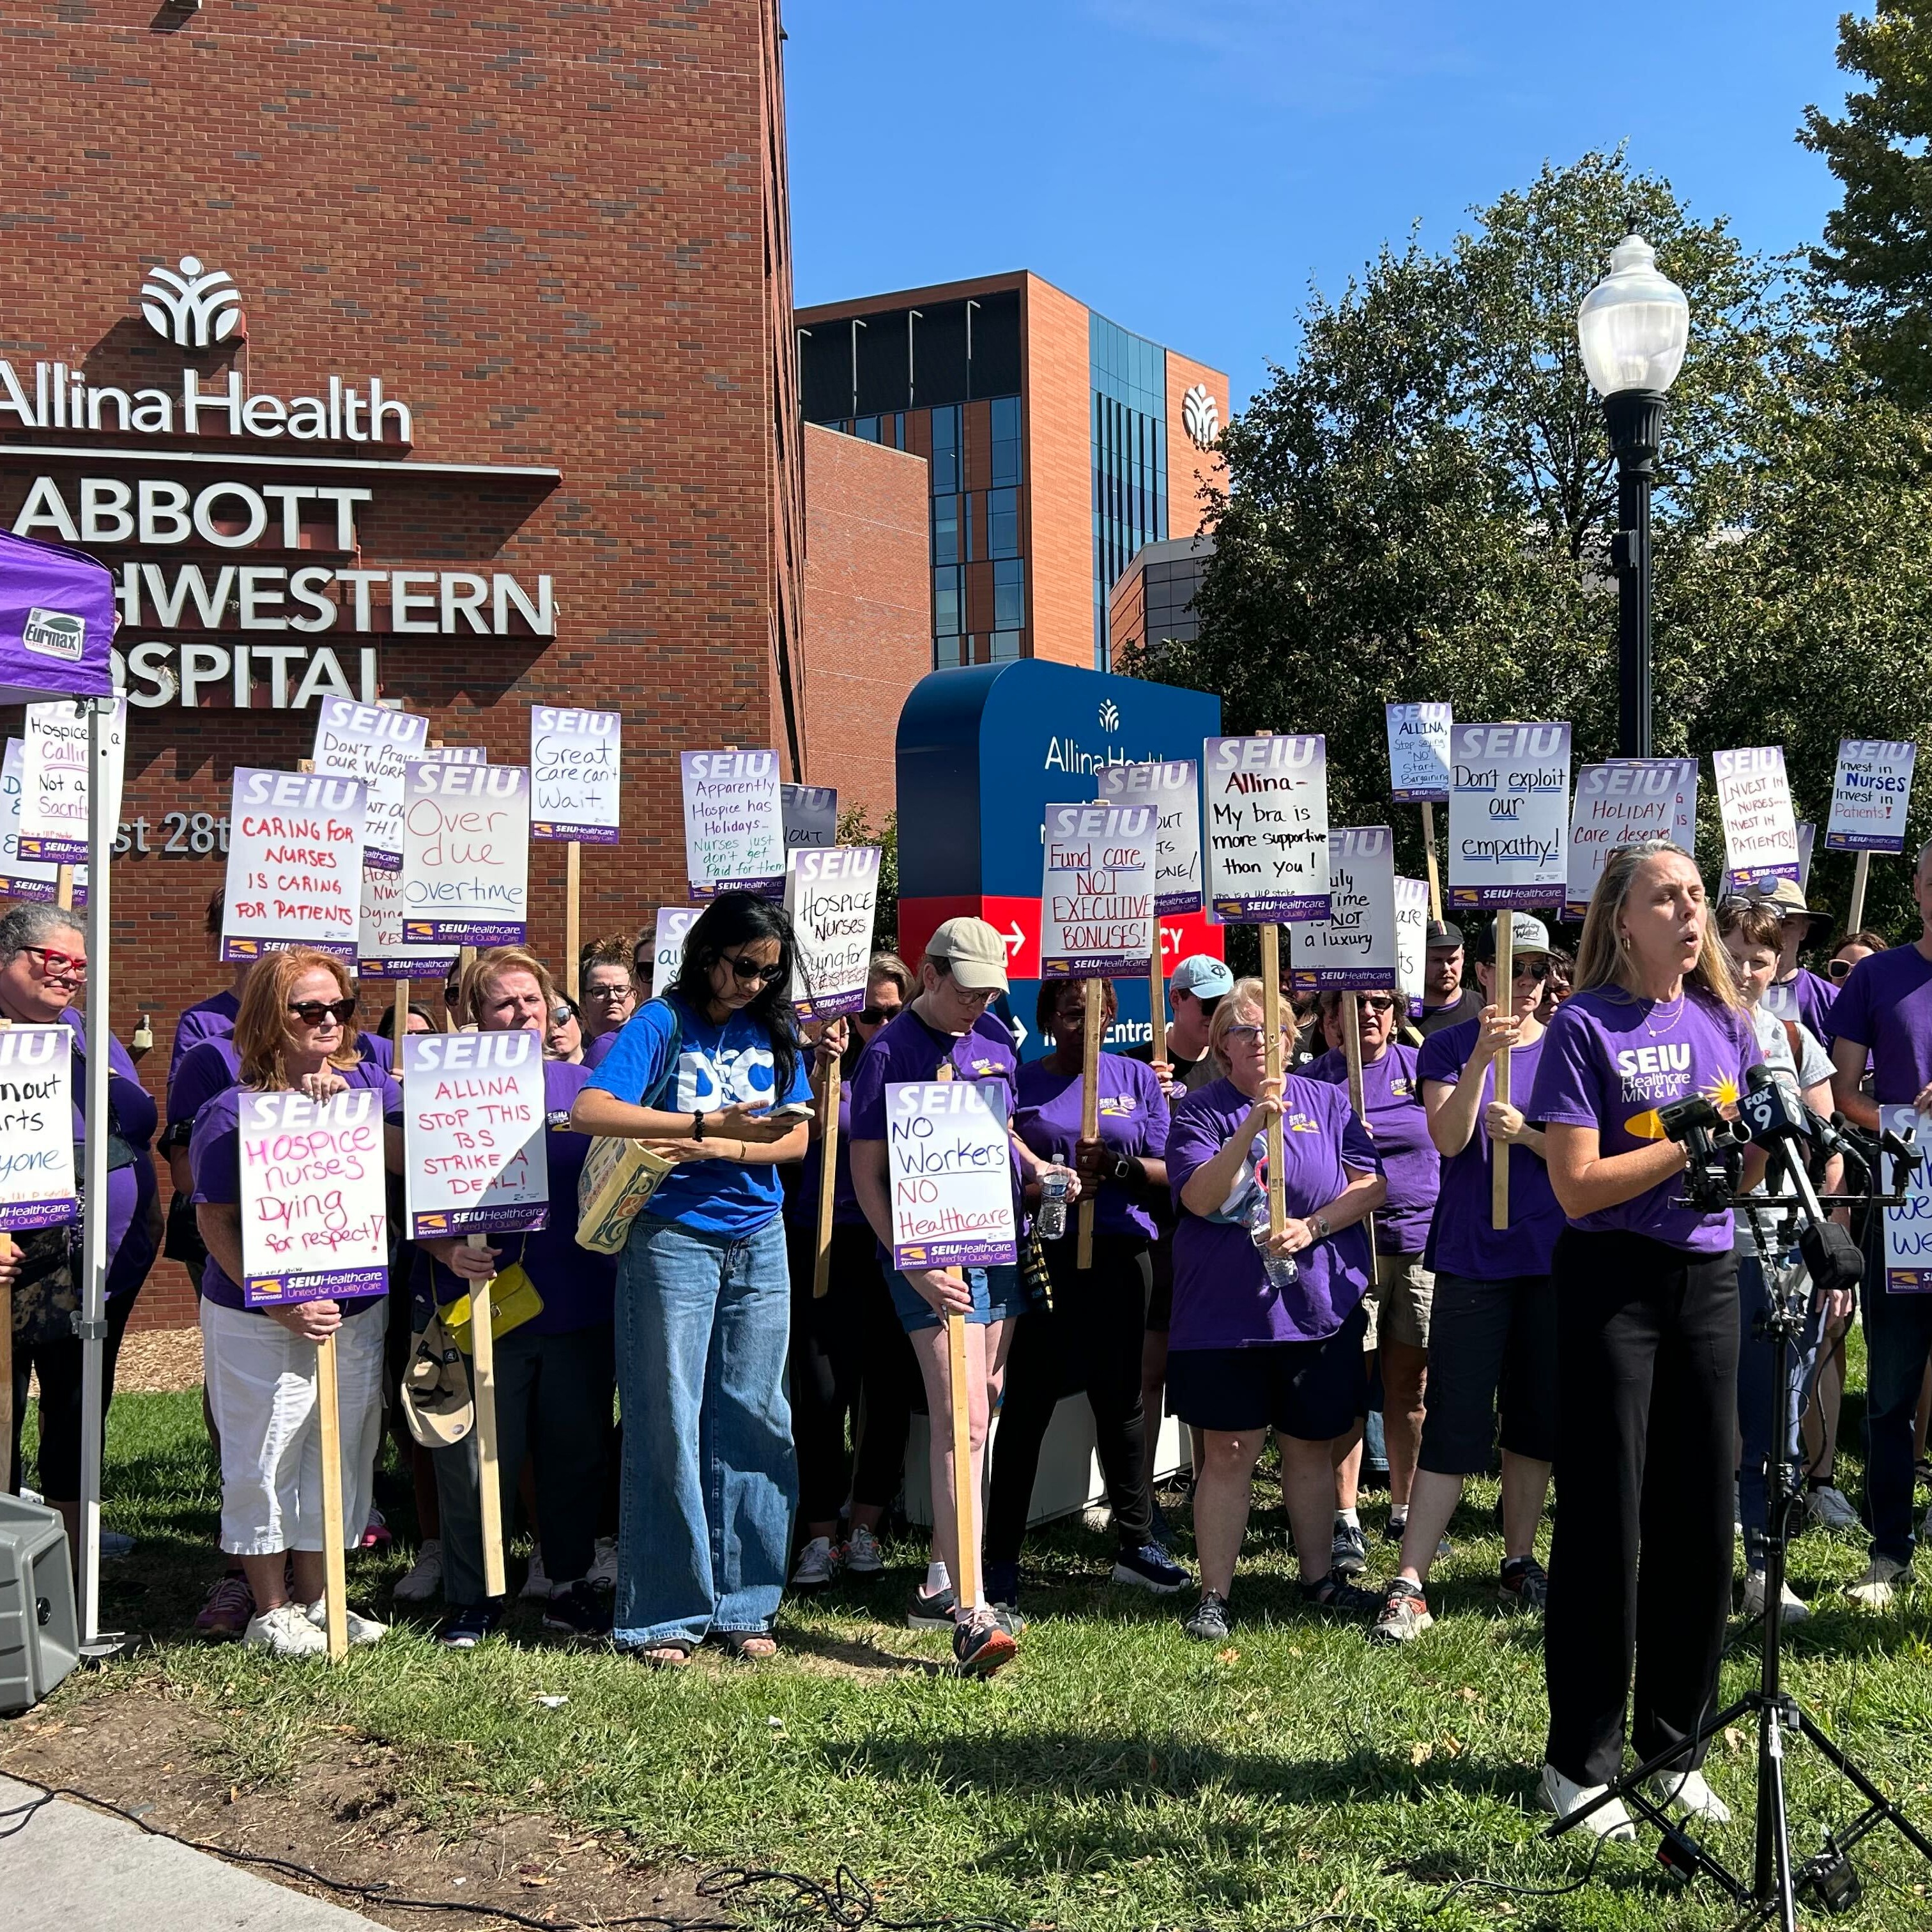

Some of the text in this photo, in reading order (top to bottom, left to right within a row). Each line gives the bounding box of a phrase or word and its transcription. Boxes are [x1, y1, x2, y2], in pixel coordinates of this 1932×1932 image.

[0, 360, 411, 443] Allina Health
[13, 476, 373, 551] ABBOTT
[26, 624, 77, 650] Eurmax
[326, 702, 419, 742] SEIU
[538, 709, 613, 736] SEIU
[1391, 705, 1446, 722] SEIU
[1399, 721, 1447, 735] ALLINA,
[323, 732, 372, 756] DON'T
[535, 735, 612, 765] Great
[1216, 738, 1315, 770] SEIU
[1394, 739, 1414, 750] Stop
[1459, 728, 1562, 759] SEIU
[1843, 741, 1910, 761] SEIU
[326, 756, 359, 772] OUR
[689, 753, 772, 779] SEIU
[1045, 736, 1105, 777] Allina
[1721, 748, 1779, 777] SEIU
[1841, 760, 1892, 774] Invest in
[40, 773, 87, 792] Not a
[243, 772, 358, 811] SEIU
[413, 765, 521, 799] SEIU
[696, 778, 775, 799] Apparently
[1106, 763, 1188, 795] SEIU
[1452, 765, 1566, 793] Don't exploit
[1584, 769, 1674, 795] SEIU
[1717, 776, 1783, 806] INVEST IN
[1846, 773, 1906, 792] Nurses
[1489, 797, 1524, 815] our
[1836, 788, 1893, 804] Invest in
[407, 799, 509, 836] Over
[693, 800, 772, 820] Hospice has
[1213, 802, 1310, 831] My bra is
[1835, 804, 1891, 819] Patients!
[242, 816, 354, 843] CARING FOR
[1054, 809, 1150, 838] SEIU
[1727, 815, 1775, 834] INVEST IN
[422, 832, 505, 866] due
[694, 835, 776, 854] Nurses just
[1213, 829, 1326, 851] more supportive
[1462, 828, 1560, 867] empathy!
[264, 845, 337, 869] NURSES
[703, 847, 770, 864] don't get
[802, 849, 874, 882] SEIU
[1050, 843, 1091, 868] Fund
[1222, 857, 1262, 875] than
[706, 860, 784, 878] Paid for them
[248, 873, 342, 894] IS CARING
[404, 877, 523, 904] Overtime
[1077, 871, 1116, 894] NOT
[235, 899, 353, 926] FOR PATIENTS
[799, 887, 873, 927] HOSPICE
[1053, 893, 1153, 921] EXECUTIVE
[1247, 907, 1324, 919] United Quality Care
[1483, 898, 1502, 907] United
[1519, 898, 1544, 907] Quality
[1544, 898, 1560, 906] Care
[815, 917, 866, 941] Nurses
[1331, 911, 1363, 926] NOT
[438, 933, 519, 943] United for Quality Care
[1062, 922, 1146, 949] BONUSES!
[1305, 931, 1372, 954] a luxury
[845, 943, 868, 965] for
[414, 1034, 530, 1072] SEIU
[1617, 1043, 1690, 1078] SEIU
[435, 1077, 519, 1100] ALLINA
[1621, 1072, 1691, 1091] Healthcare
[896, 1085, 995, 1116] SEIU
[1621, 1088, 1650, 1103] MN
[1654, 1087, 1664, 1098] &
[1744, 1087, 1772, 1110] FOX
[250, 1092, 372, 1130] SEIU
[418, 1105, 531, 1130] STOP THIS
[548, 1111, 567, 1119] SEIU
[1754, 1104, 1772, 1130] 9
[1788, 1101, 1802, 1125] 9
[892, 1117, 933, 1143] NO
[424, 1148, 529, 1175] STRIKE A
[897, 1137, 1005, 1173] Workers
[265, 1155, 365, 1192] nurses
[447, 1171, 526, 1195] DEAL!
[898, 1179, 938, 1206] NO
[256, 1190, 348, 1230] Dying
[264, 1215, 385, 1254] for respect!
[482, 1221, 494, 1230] for
[900, 1207, 1011, 1239] Healthcare
[931, 1255, 956, 1263] United
[958, 1254, 967, 1262] for
[969, 1254, 993, 1264] Quality
[288, 1282, 381, 1298] United for Quality Care
